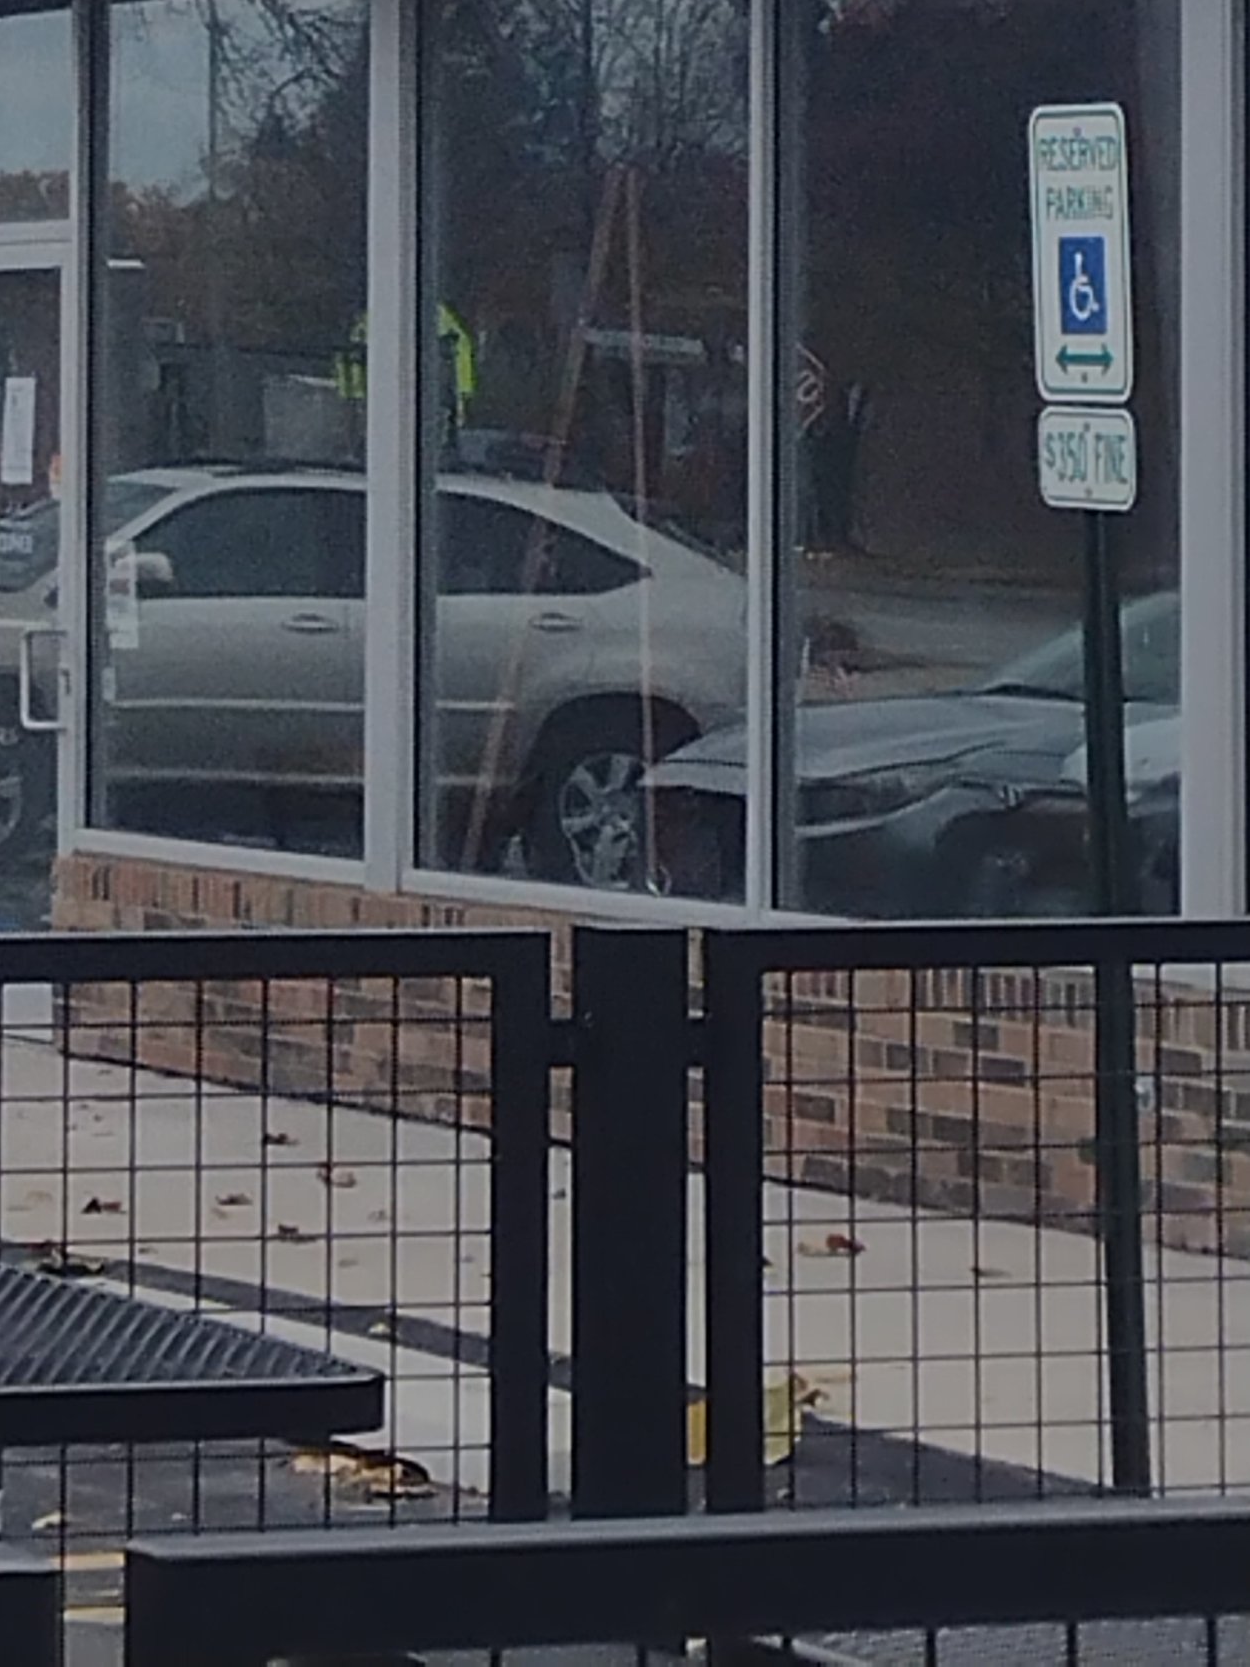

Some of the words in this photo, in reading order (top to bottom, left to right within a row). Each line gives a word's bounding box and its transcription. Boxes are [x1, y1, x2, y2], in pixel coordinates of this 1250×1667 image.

[1038, 135, 1118, 171] RESERVED
[1045, 185, 1114, 220] PARKING
[1044, 432, 1088, 483] $350
[1094, 433, 1129, 485] FINE
